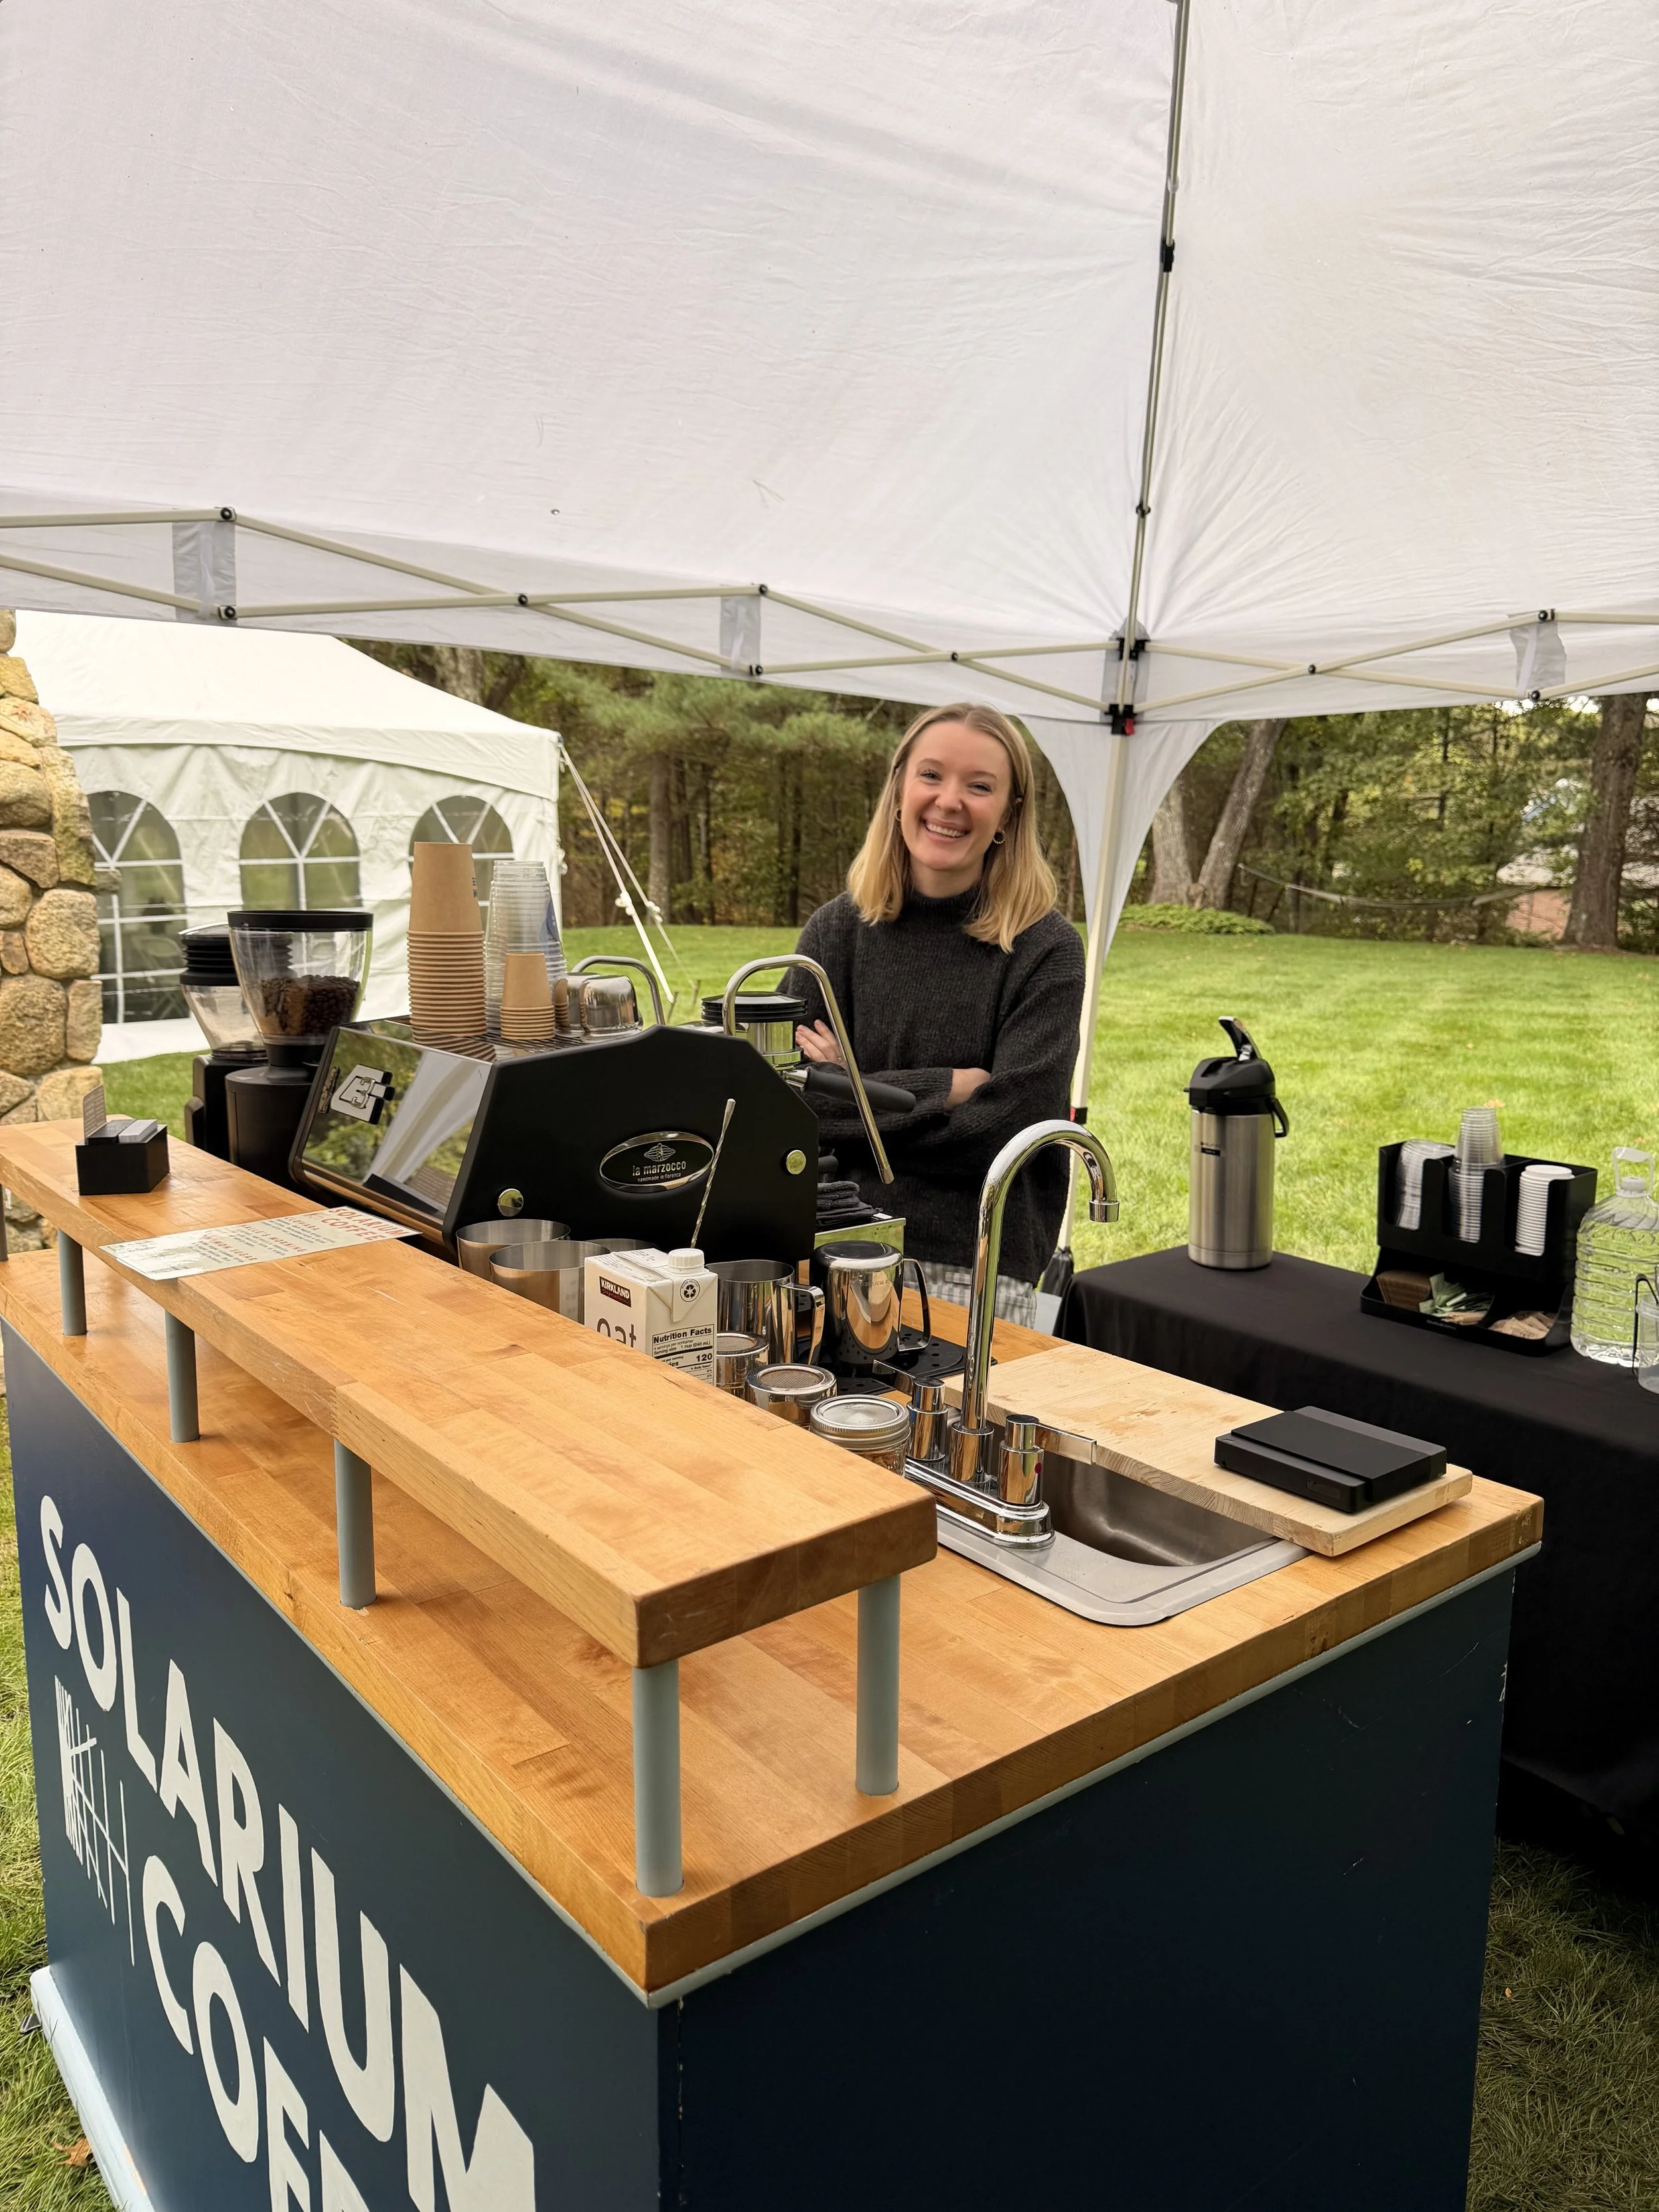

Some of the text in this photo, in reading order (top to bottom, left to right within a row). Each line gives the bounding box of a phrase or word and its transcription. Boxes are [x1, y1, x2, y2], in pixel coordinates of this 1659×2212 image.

[632, 1161, 686, 1176] la marzocco
[321, 1218, 386, 1240] COFFEE
[329, 1209, 411, 1236] SOLARIUM
[230, 1248, 258, 1261] SUGAR
[601, 1279, 630, 1299] KIRKLAND
[597, 1318, 636, 1348] oat
[654, 1327, 712, 1344] Nutrition Facts
[695, 1353, 713, 1363] 120
[40, 1495, 536, 2212] SOLARIUM
